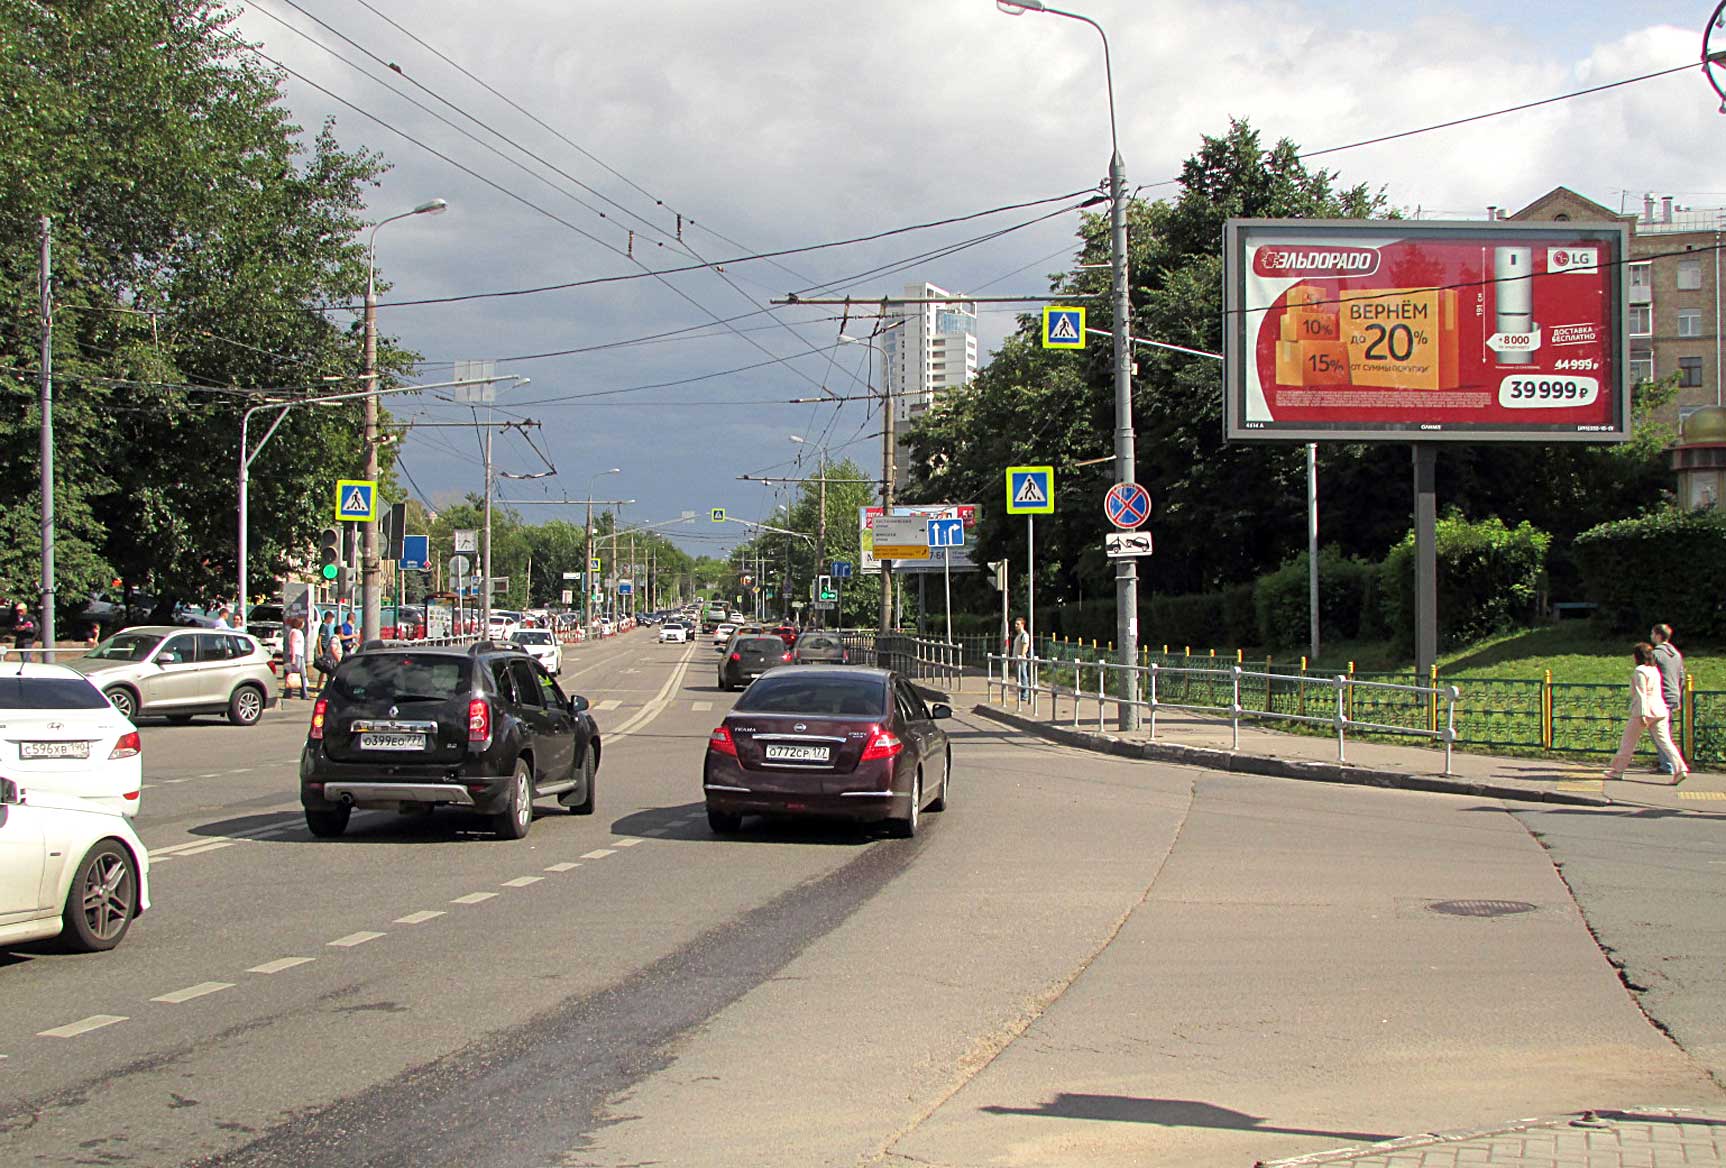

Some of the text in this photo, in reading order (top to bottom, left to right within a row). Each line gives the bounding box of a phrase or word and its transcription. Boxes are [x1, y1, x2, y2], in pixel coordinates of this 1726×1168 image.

[1572, 253, 1589, 264] LG
[1351, 300, 1428, 320] ВЕРНЁМ
[1303, 319, 1333, 335] 10%
[1553, 327, 1593, 336] ДОСТАВКА
[1551, 333, 1596, 343] БЕСПЛАТНО
[1308, 354, 1344, 372] 15%
